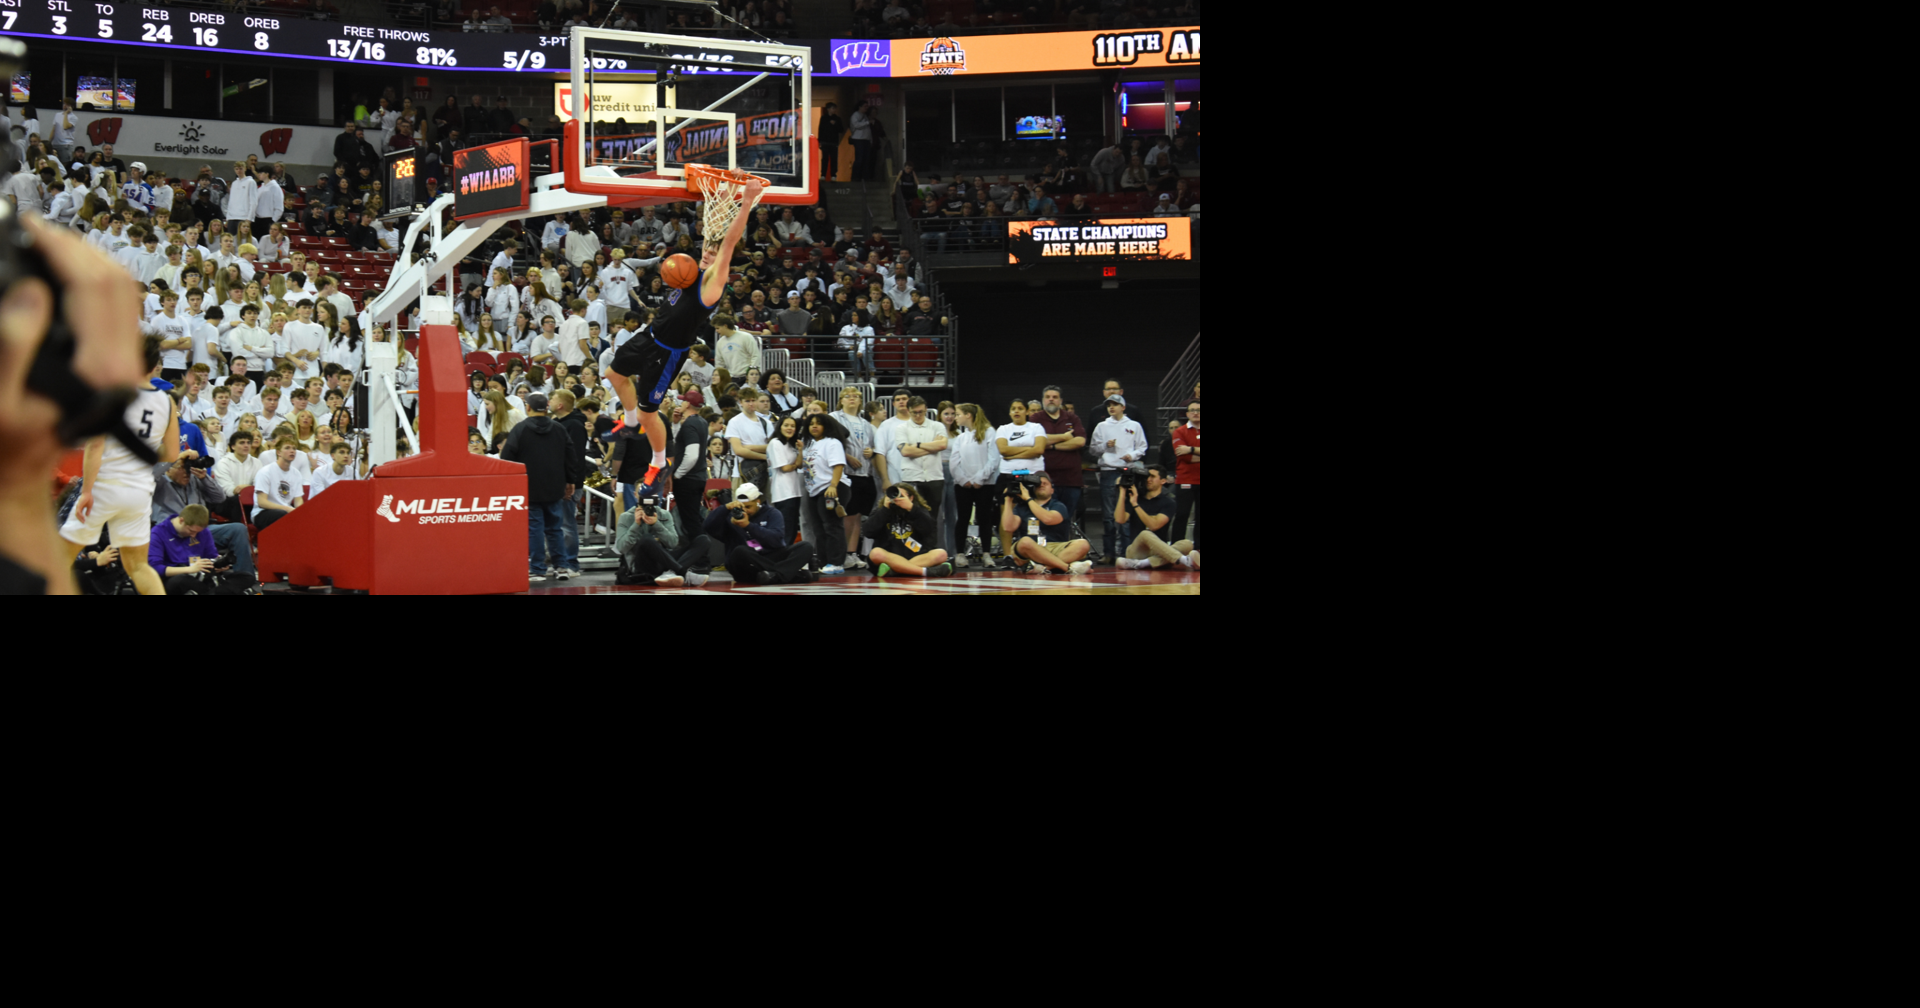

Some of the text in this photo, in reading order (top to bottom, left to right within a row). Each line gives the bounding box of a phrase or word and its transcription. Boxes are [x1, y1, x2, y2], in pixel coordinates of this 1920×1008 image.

[47, 0, 73, 12] STL
[94, 3, 114, 16] TO
[142, 8, 170, 21] REB
[1, 10, 18, 30] 7
[51, 15, 67, 35] 3
[189, 12, 225, 25] DREB
[244, 17, 280, 30] OREB
[97, 19, 113, 38] 5
[142, 23, 173, 43] 24
[193, 27, 219, 46] 16
[343, 25, 430, 43] FREE THROWS
[254, 32, 269, 50] 8
[327, 39, 386, 61] 13/16
[538, 36, 568, 47] 3-PT
[1096, 33, 1160, 63] 110TH
[416, 47, 457, 66] 81%
[503, 50, 546, 71] 5/9
[832, 41, 889, 74] WL
[921, 51, 964, 65] STATE
[593, 95, 613, 103] uw
[593, 102, 672, 113] credit uni
[154, 142, 229, 156] Everlight Solar
[460, 165, 515, 195] #WIAABB
[640, 226, 658, 235] GAP
[1032, 223, 1166, 242] STATE CHAMPIONS
[1041, 240, 1158, 256] ARE MADE HERE
[138, 409, 154, 439] 5
[418, 512, 503, 525] SPORTS MEDICINE
